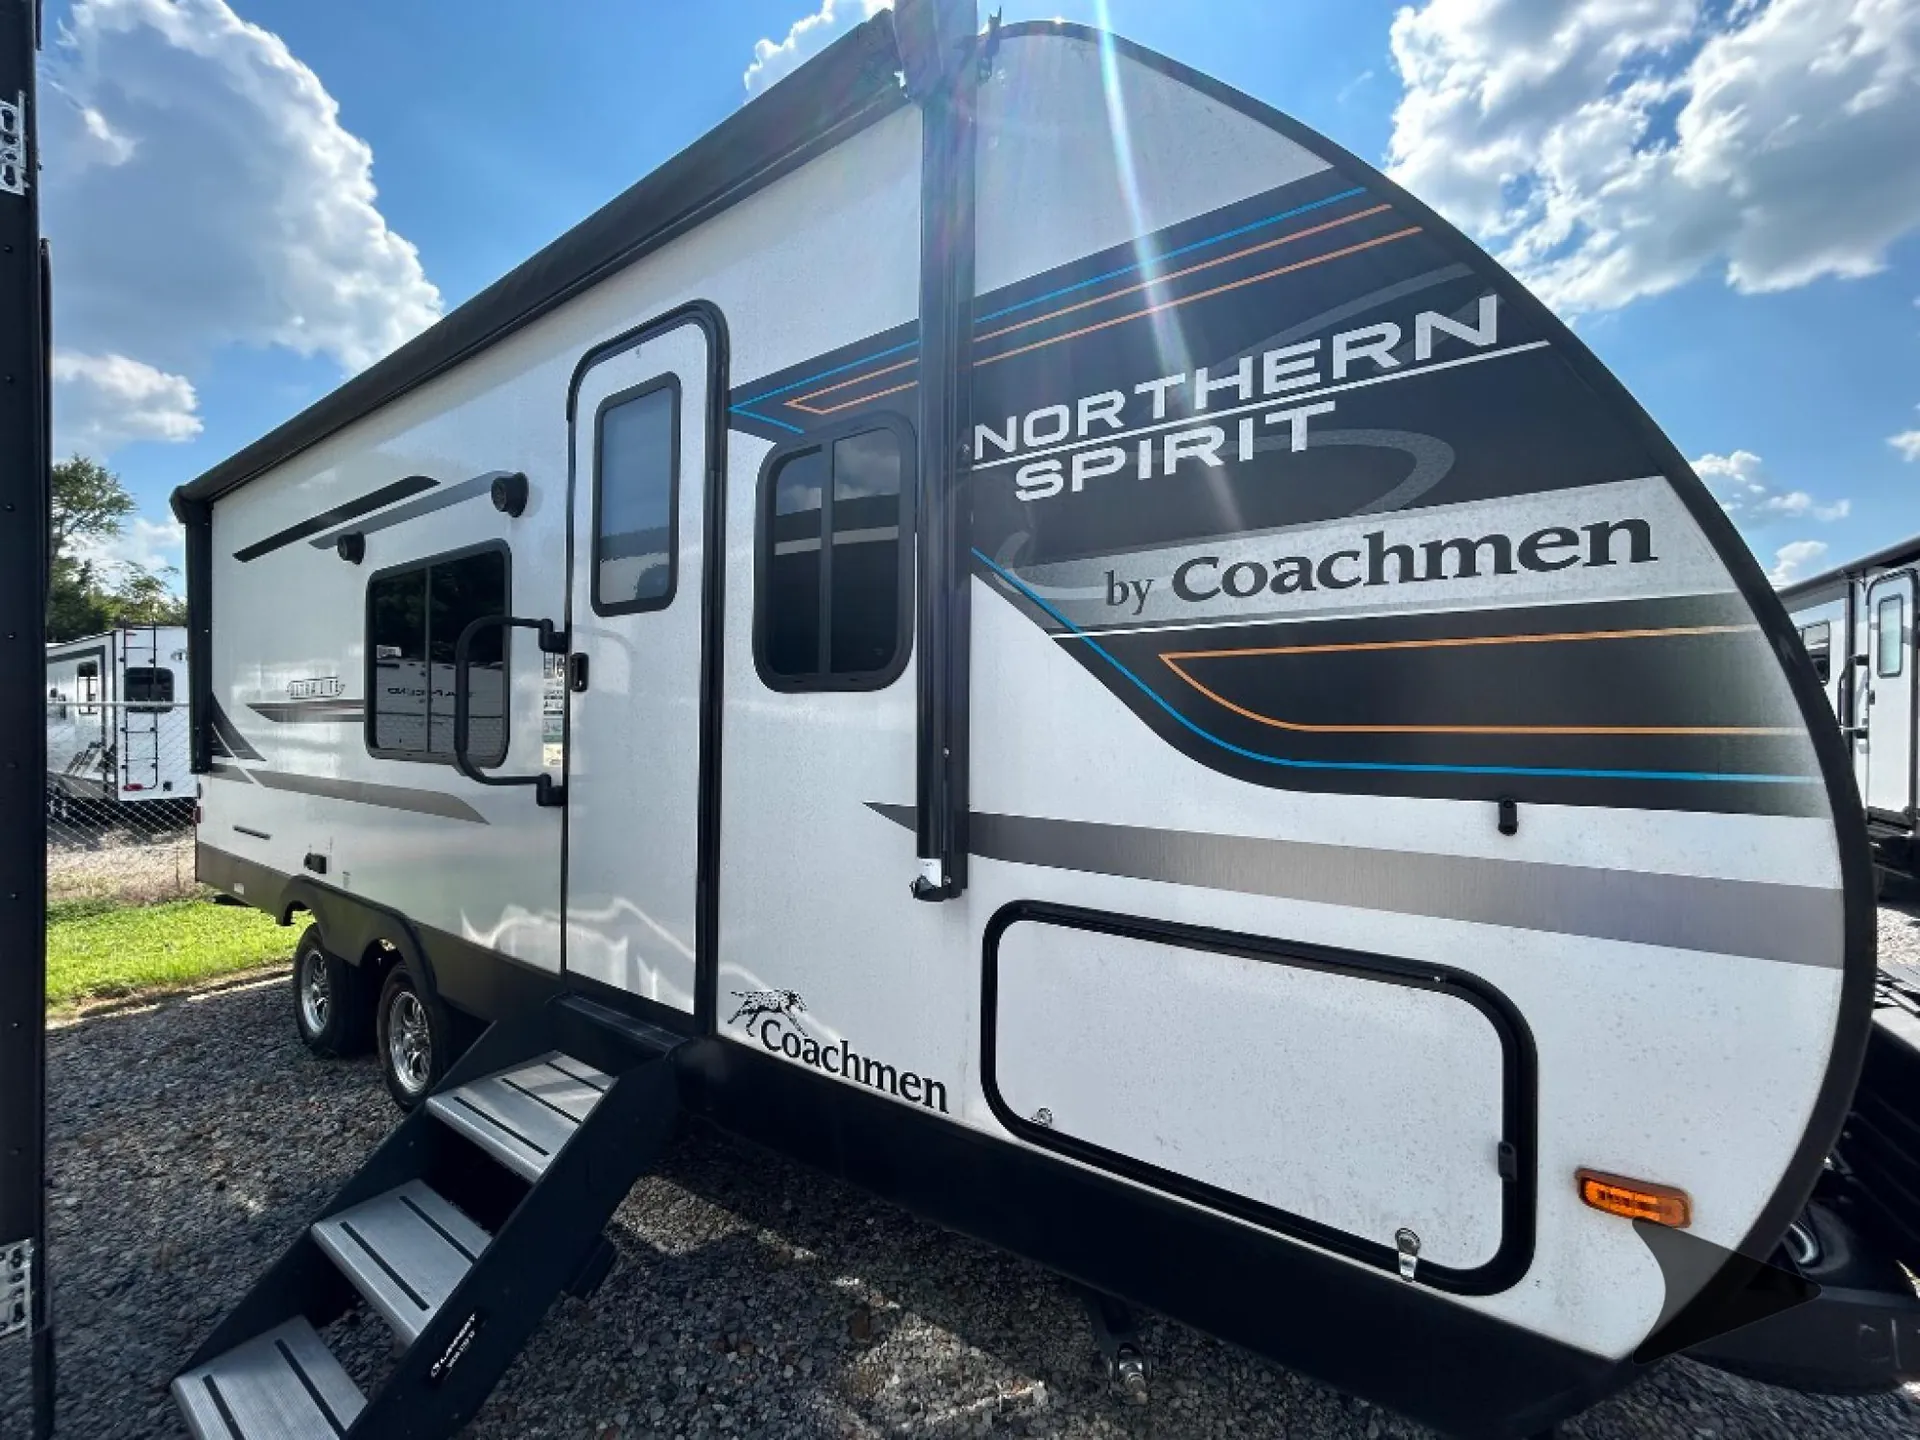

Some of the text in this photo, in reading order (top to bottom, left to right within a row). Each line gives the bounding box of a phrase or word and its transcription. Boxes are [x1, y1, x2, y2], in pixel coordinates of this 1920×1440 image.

[974, 293, 1498, 460] NORTHERN
[1015, 400, 1336, 502] SPIRIT
[1105, 516, 1659, 616] by Coachmen
[760, 1019, 950, 1115] Coachmen
